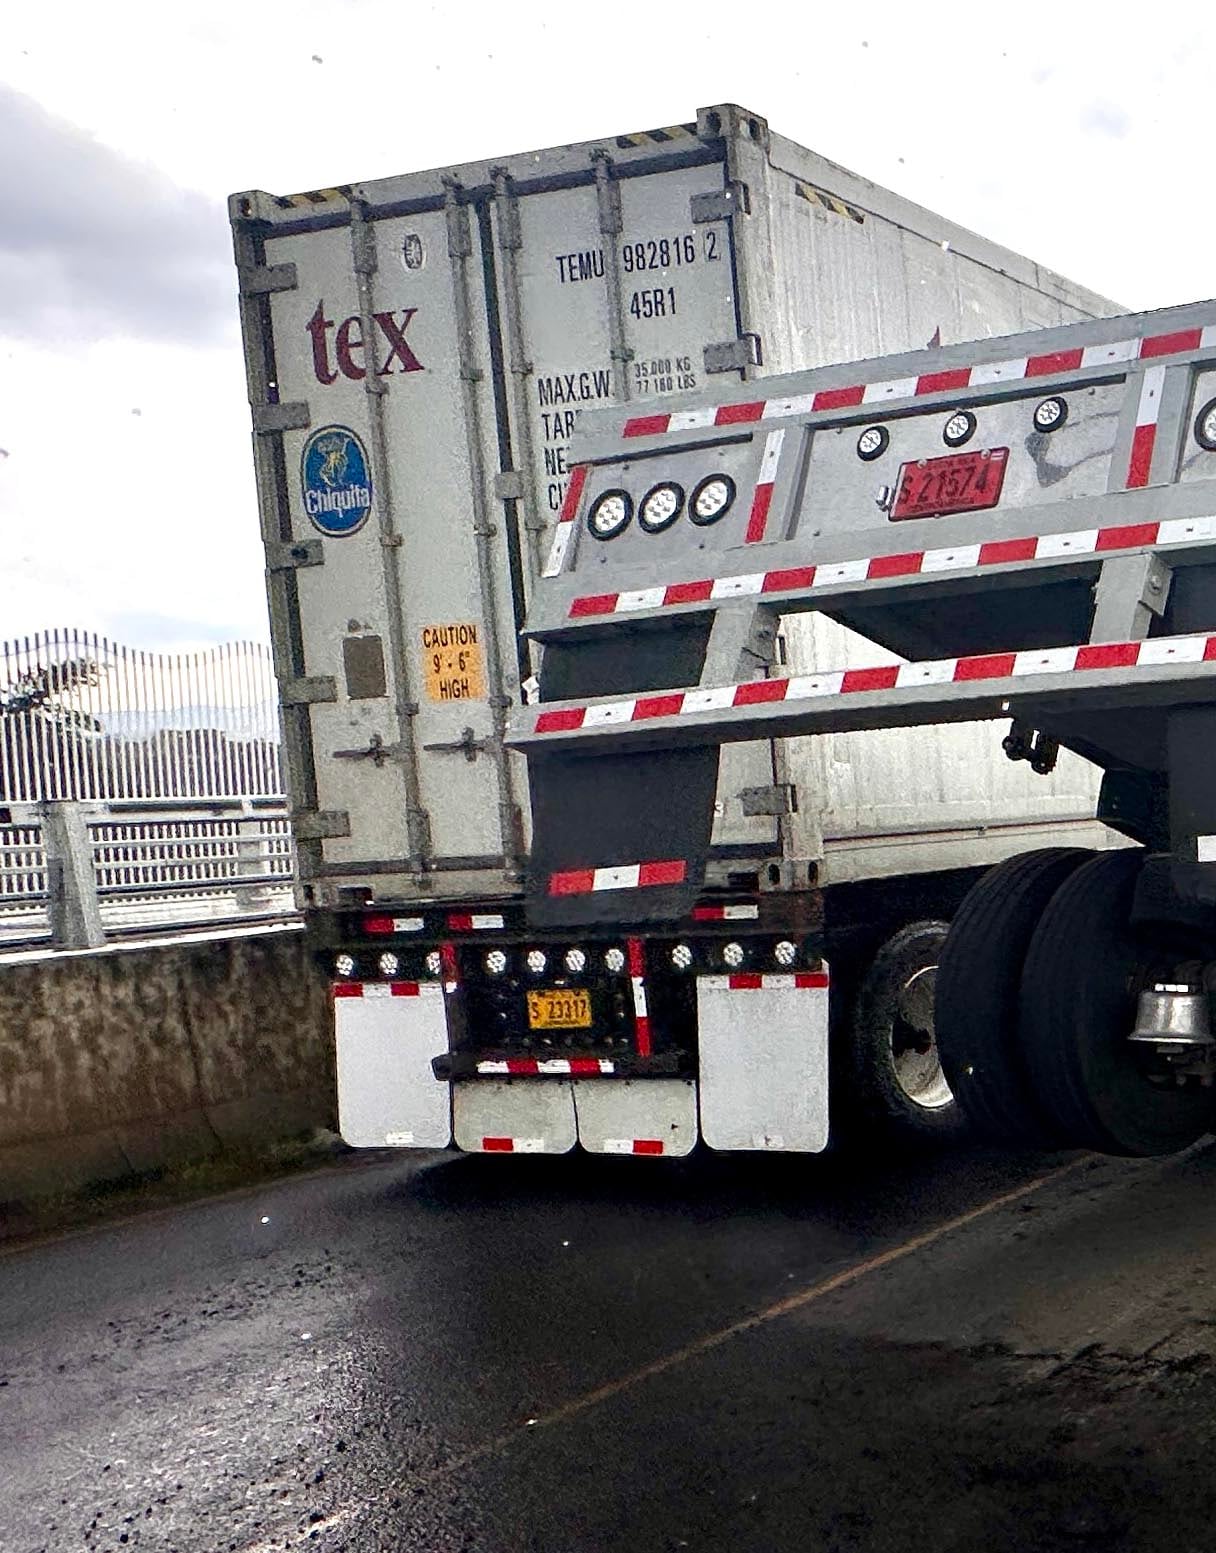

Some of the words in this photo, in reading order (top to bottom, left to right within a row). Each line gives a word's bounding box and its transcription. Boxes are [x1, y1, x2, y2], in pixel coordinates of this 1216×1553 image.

[556, 250, 605, 283] TEMU
[623, 235, 696, 273] 982816
[706, 232, 718, 260] 2
[630, 287, 677, 320] 45R1
[305, 298, 426, 386] tex
[676, 356, 692, 373] KG
[677, 373, 697, 390] LBS
[541, 410, 581, 441] TAR
[304, 484, 371, 519] Chiquita
[898, 475, 913, 504] S
[423, 625, 477, 648] CAUTION
[440, 679, 469, 699] HIGH
[532, 1002, 539, 1019] S
